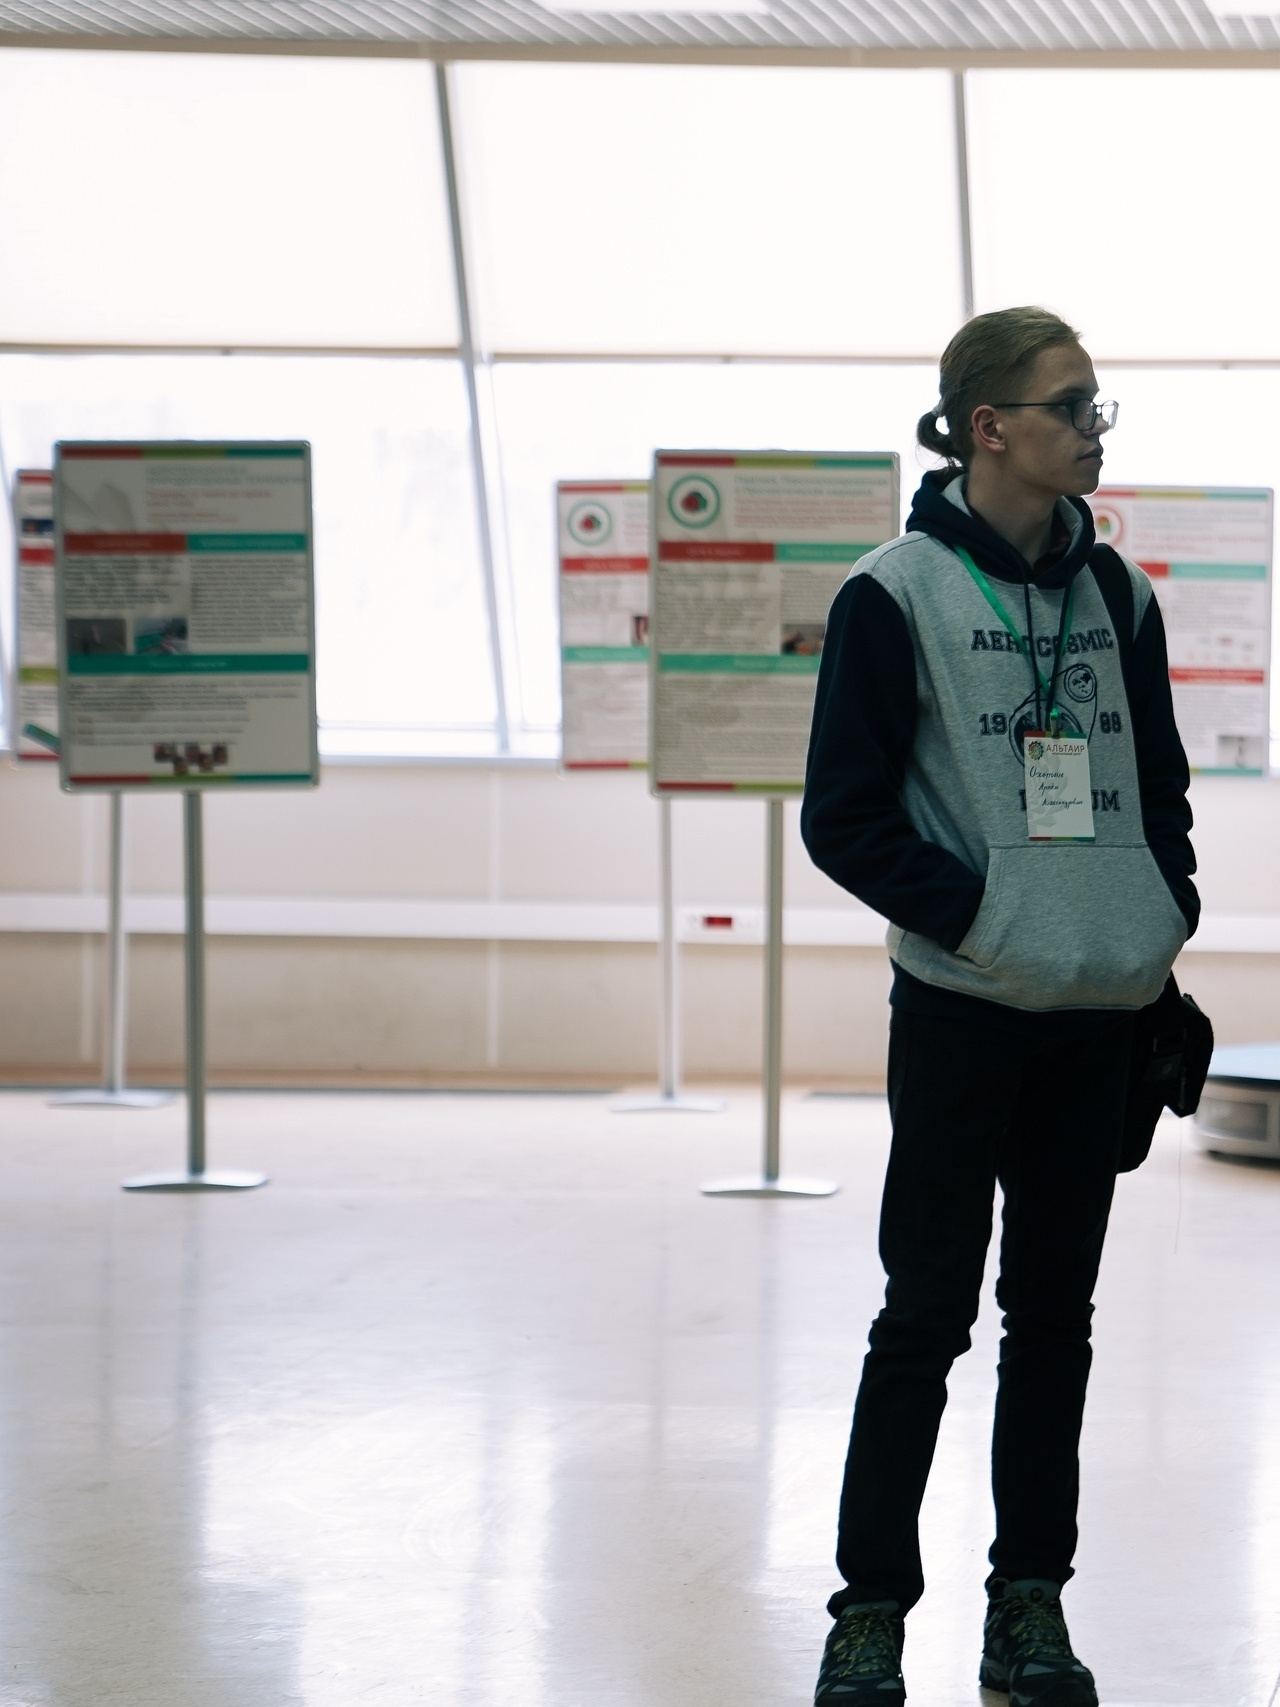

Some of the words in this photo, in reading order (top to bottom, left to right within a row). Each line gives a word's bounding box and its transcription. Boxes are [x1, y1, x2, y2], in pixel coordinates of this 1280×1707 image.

[979, 712, 1008, 736] 19
[1100, 711, 1122, 734] 88
[1046, 744, 1085, 753] АЛЬТАИР
